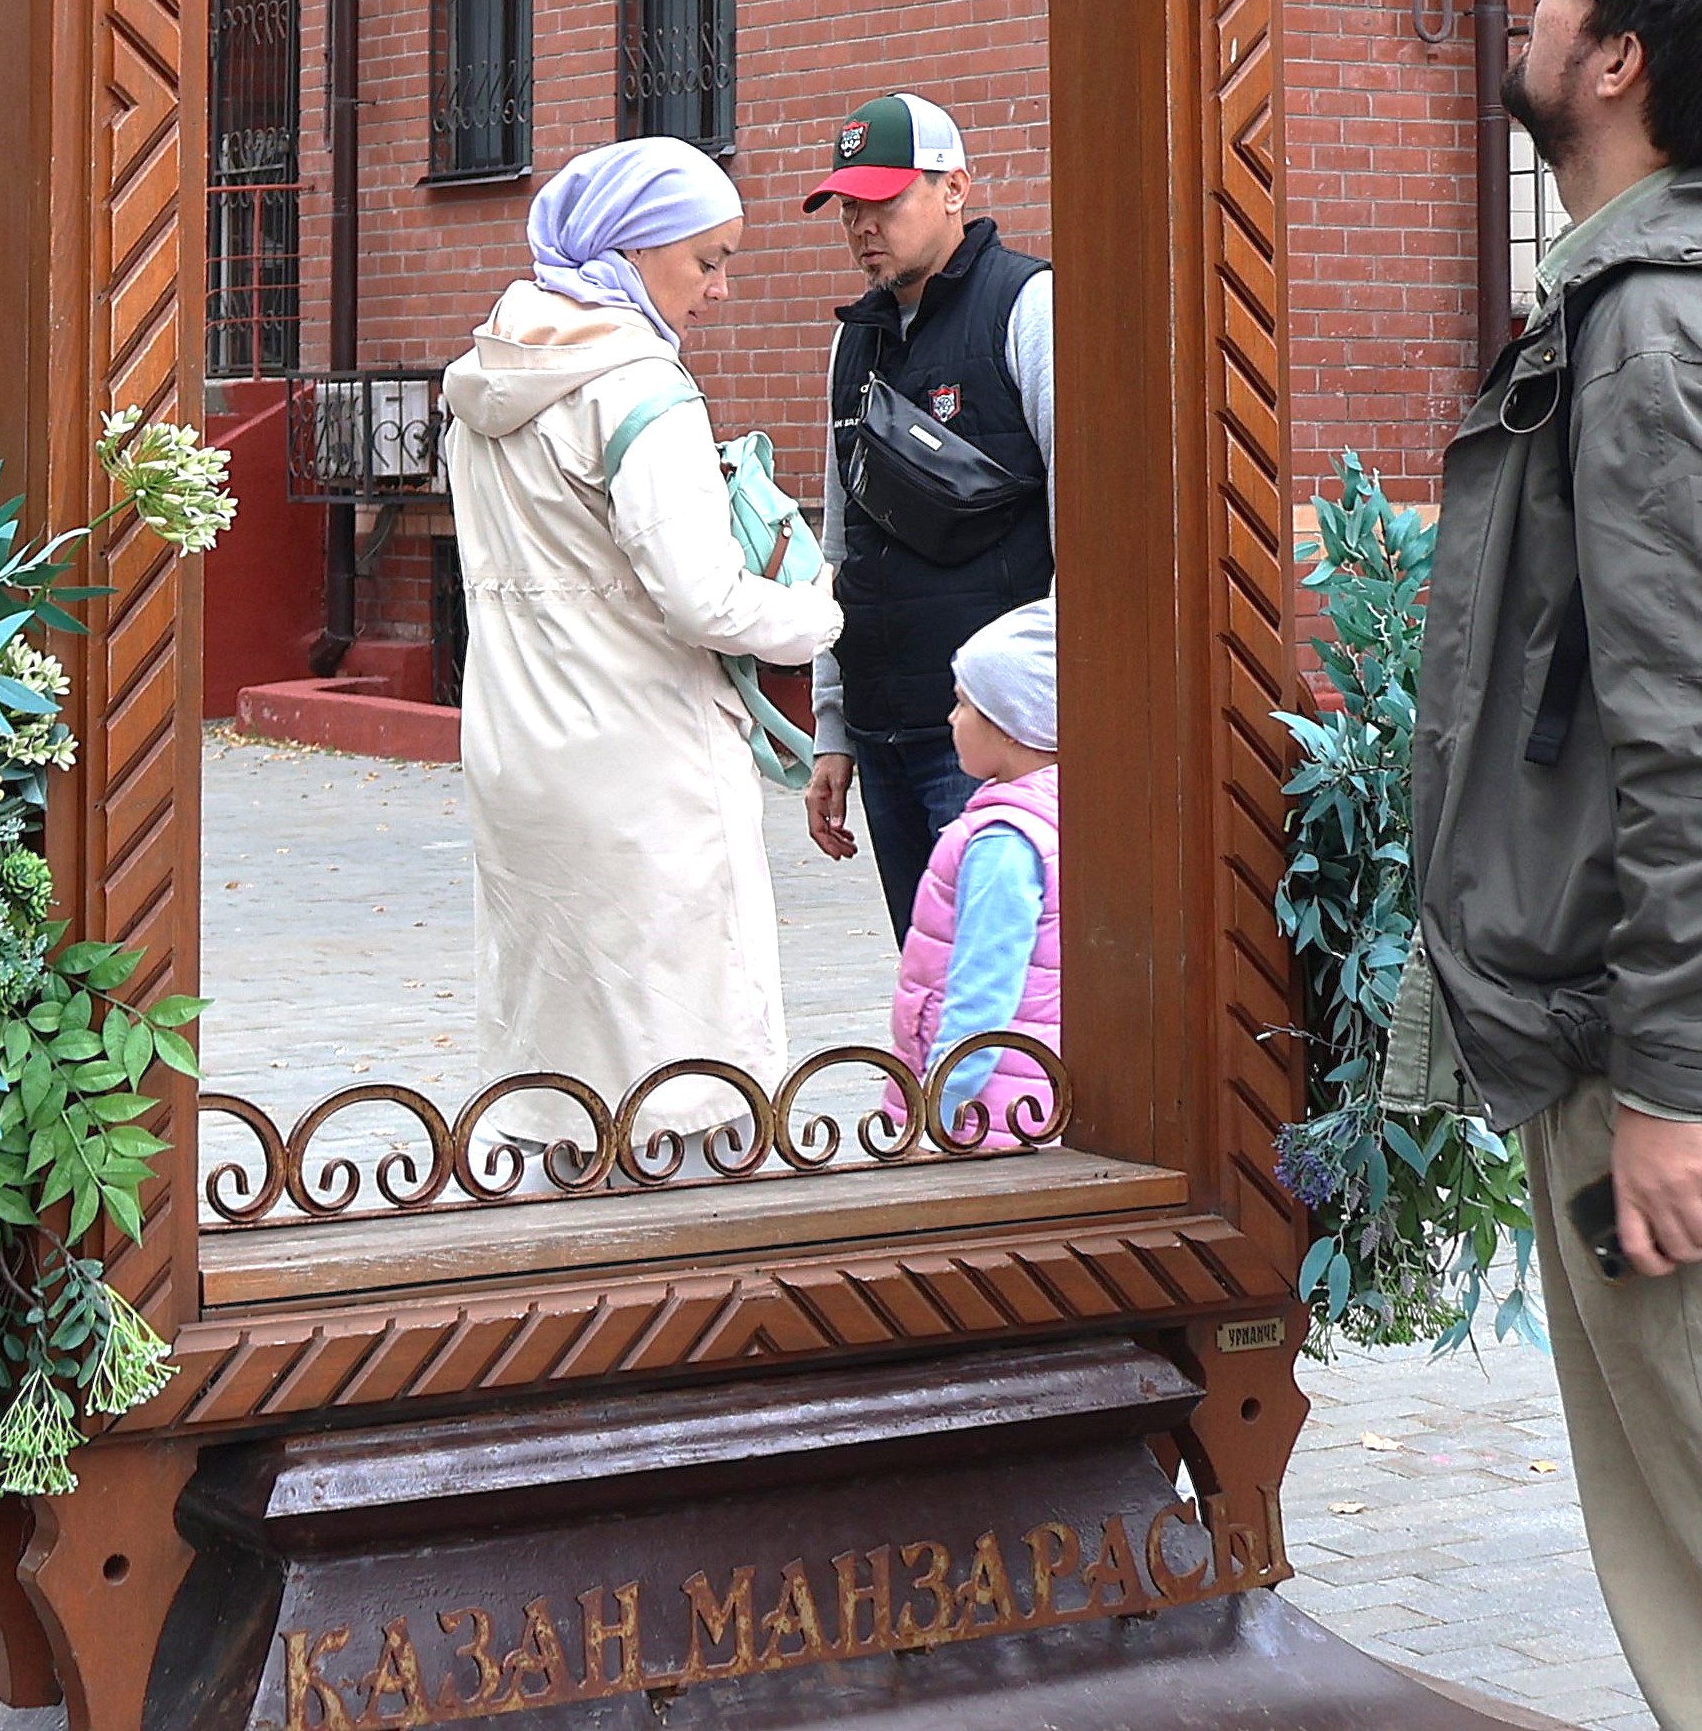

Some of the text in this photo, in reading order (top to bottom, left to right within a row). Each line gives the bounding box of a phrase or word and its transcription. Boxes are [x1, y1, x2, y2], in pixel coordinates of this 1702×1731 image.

[1228, 1323, 1277, 1347] УРМАНЧЕ
[278, 1481, 1296, 1731] КАЗАН МАНЗАРАСЫ
